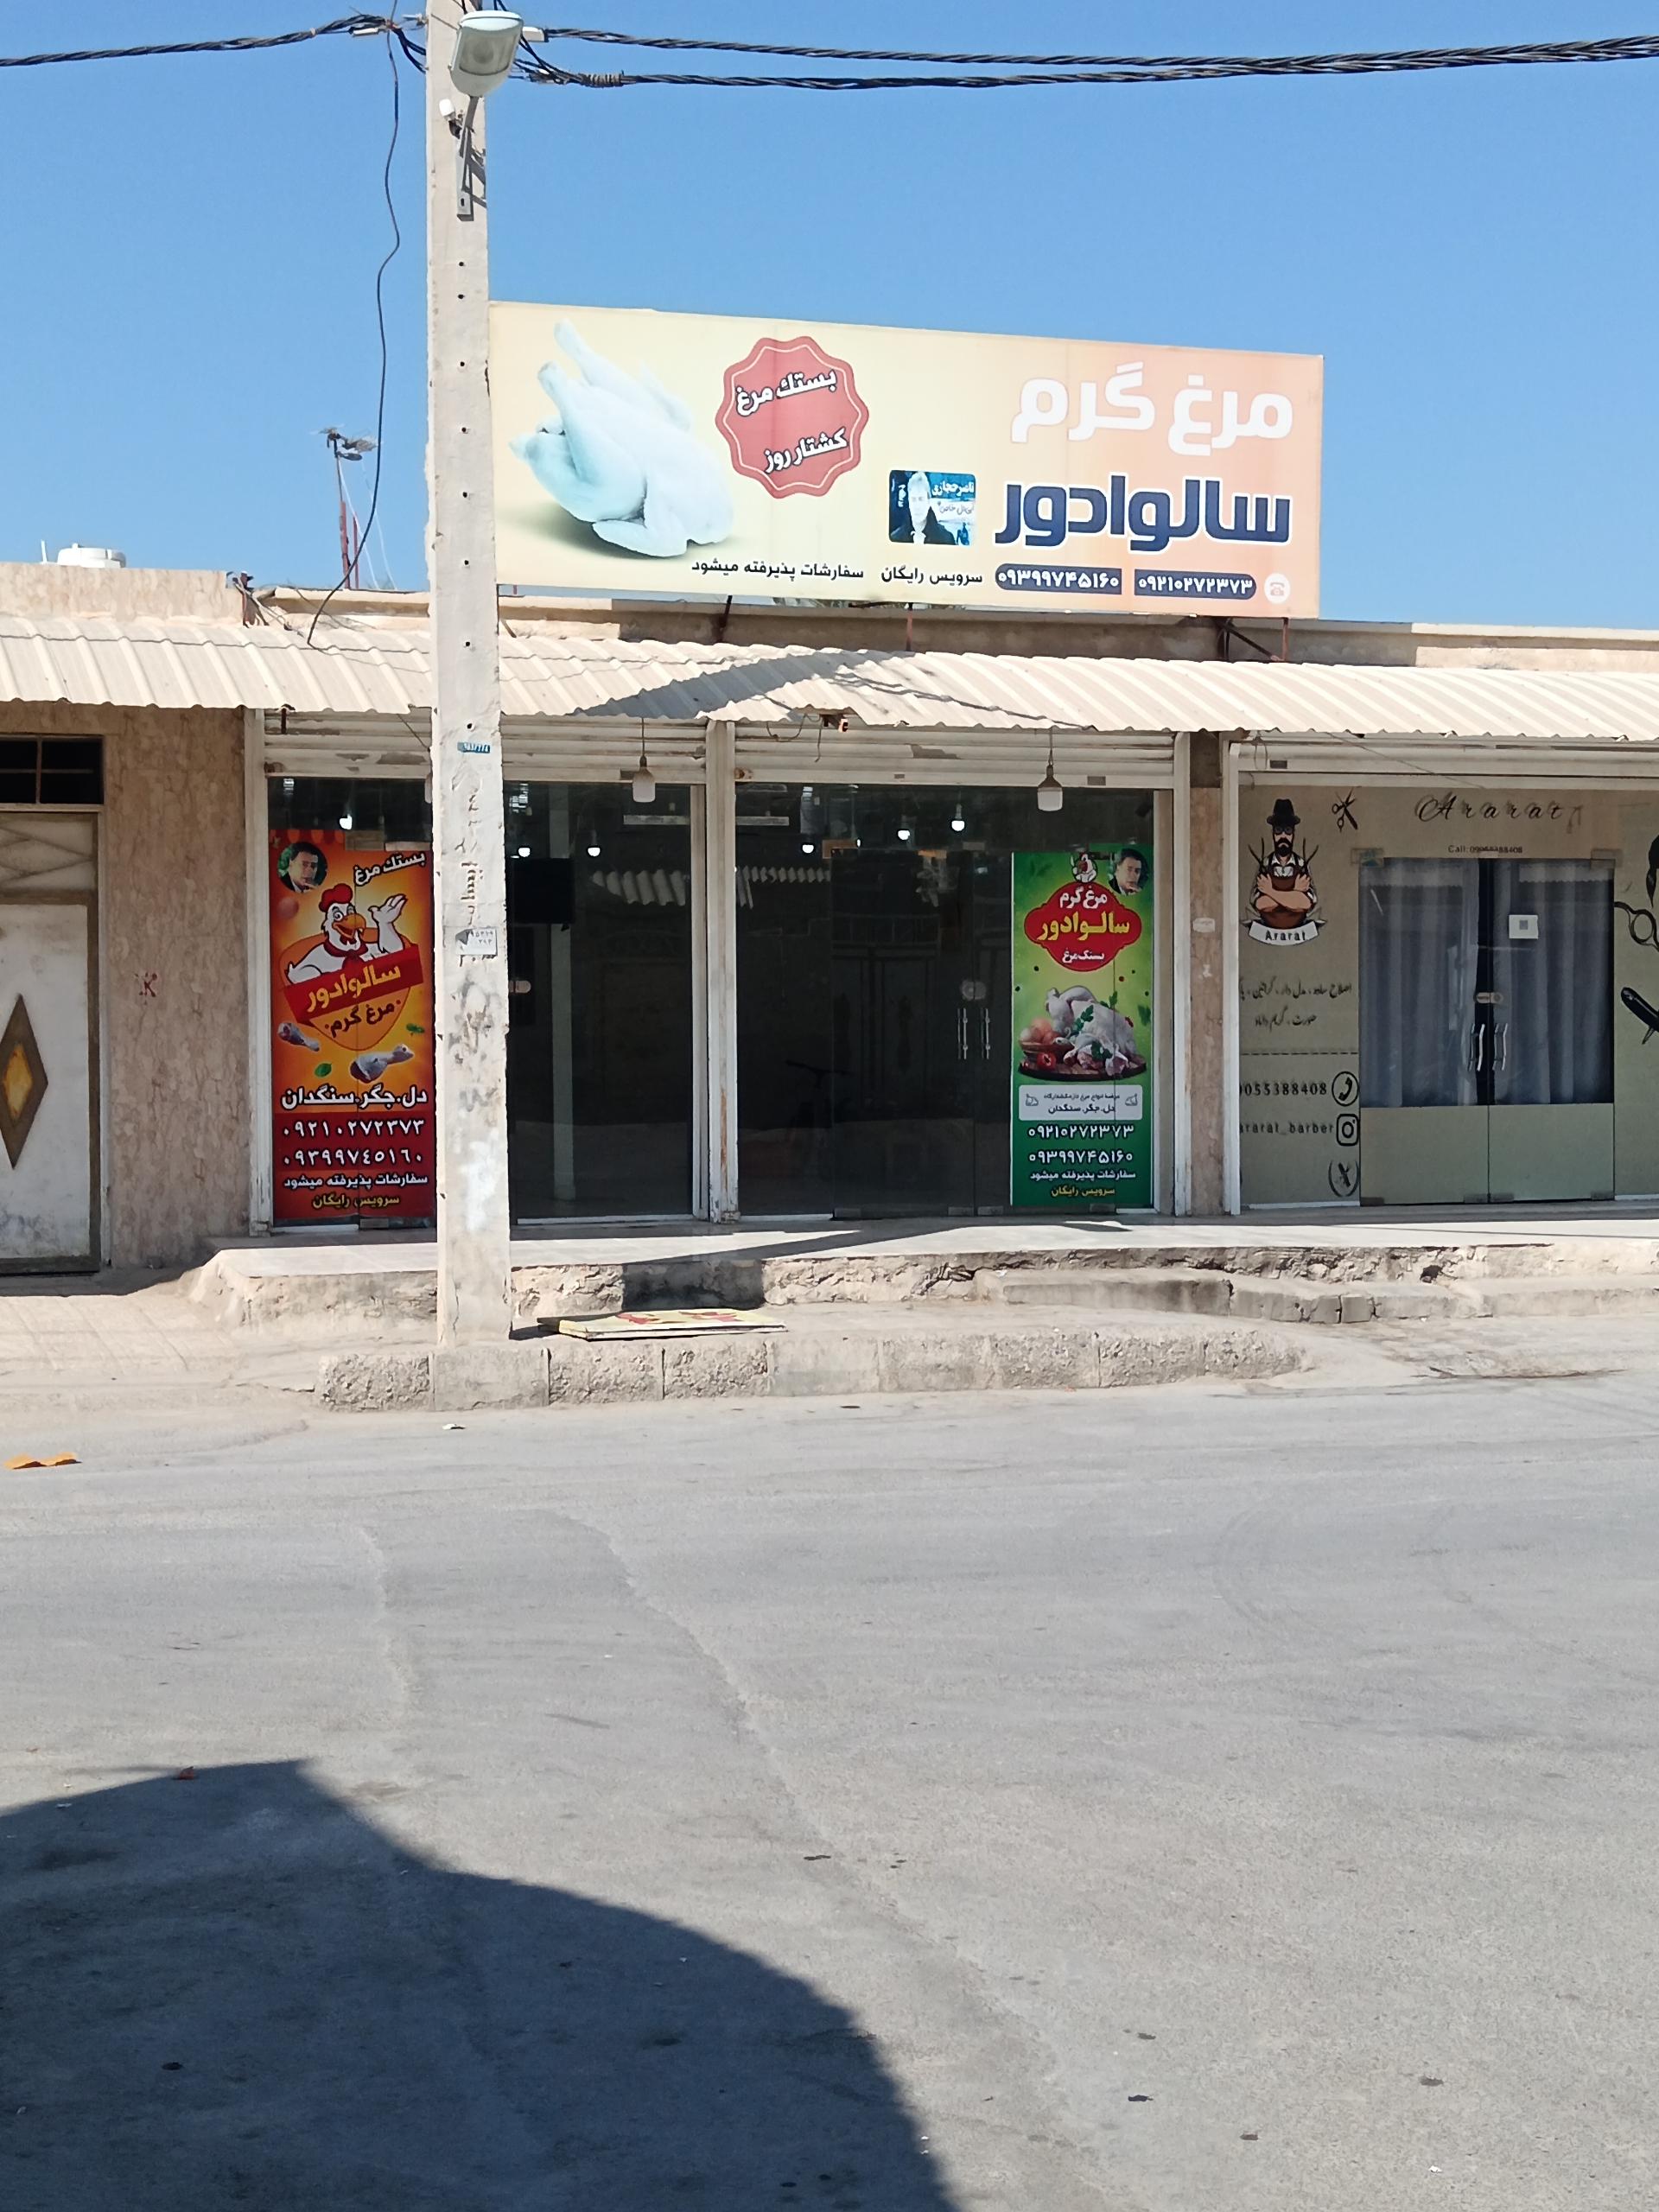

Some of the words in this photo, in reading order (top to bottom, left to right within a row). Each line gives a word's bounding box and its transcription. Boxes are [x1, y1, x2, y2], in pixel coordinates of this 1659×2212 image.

[736, 386, 773, 416] مرغ
[1012, 361, 1154, 443] گرم
[1168, 374, 1293, 456] مرغ
[792, 427, 849, 465] کشتار
[765, 449, 791, 474] روز
[995, 474, 1290, 551] سالوادور
[691, 558, 739, 576] میشود
[744, 560, 795, 582] پذیرفته
[801, 564, 864, 580] سفارشات
[880, 565, 924, 584] رایگان
[929, 570, 982, 586] سرویس
[998, 570, 1119, 588] ۰۹۳۹۹۷۴۵۱۶۰
[1138, 578, 1253, 594] ۰۹۲۱۰۲۷۲۳۷۳
[1417, 793, 1564, 822] Ararat
[354, 864, 380, 886] مرغ
[1060, 887, 1084, 908] گرم
[1083, 885, 1107, 908] مرغ
[1037, 912, 1129, 940] سالوادور
[1265, 931, 1306, 941] Ararat
[1062, 947, 1078, 963] مرغ
[307, 964, 401, 1012] سالوادور
[329, 1005, 362, 1037] گرم
[365, 1002, 394, 1024] مرغ
[1028, 1125, 1134, 1138] ۰۹۲۱۰۲۷۲۳۷۳
[1029, 1150, 1133, 1163] ۰۹۳۹۹۷۴۵۱۶۰
[284, 1175, 322, 1189] میشود
[327, 1174, 372, 1189] پذیرفته
[375, 1173, 429, 1187] سفارشات
[1030, 1171, 1058, 1181] میشود
[1062, 1170, 1095, 1181] پذیرفته
[1097, 1169, 1135, 1180] سفارشات
[313, 1192, 349, 1208] رایگان
[1052, 1185, 1078, 1197] رایگان
[1082, 1187, 1115, 1196] سرویس
[354, 1196, 399, 1207] سرویس
